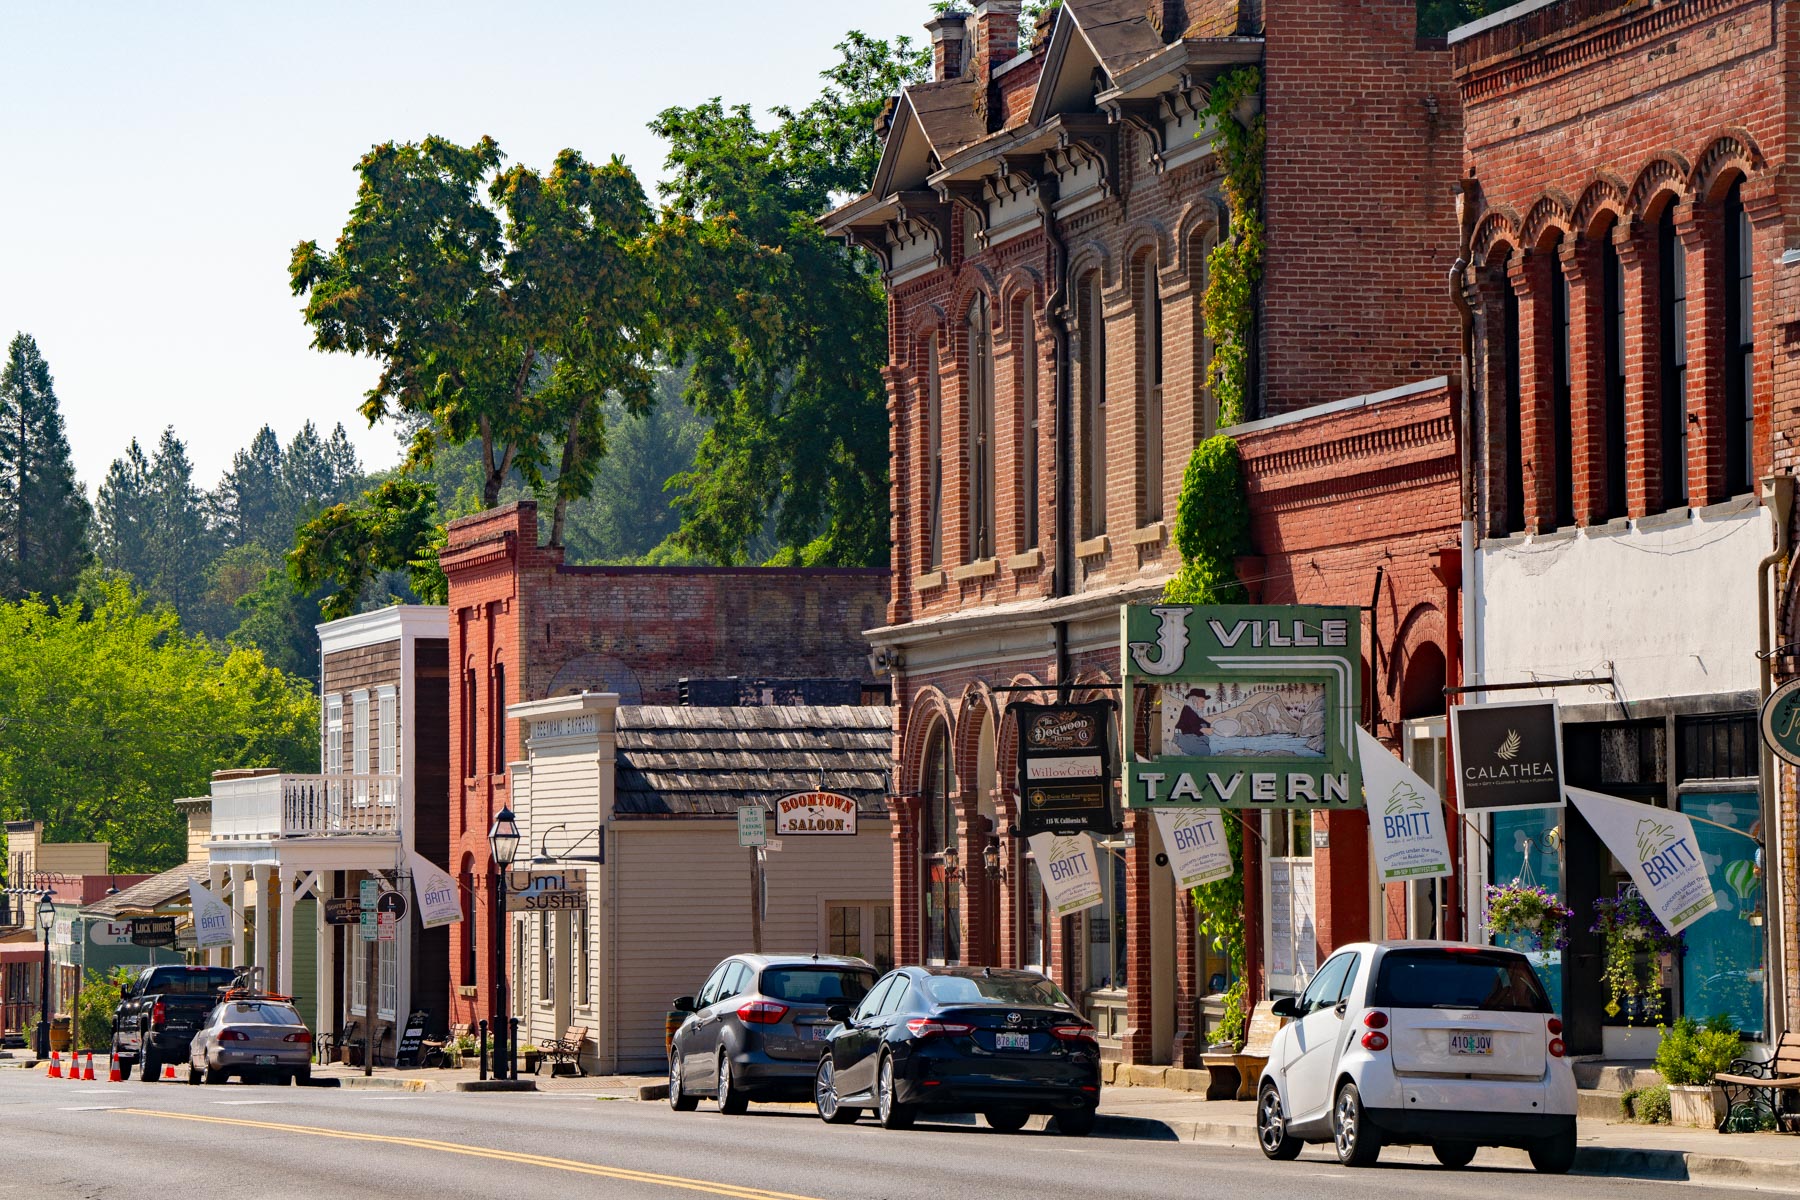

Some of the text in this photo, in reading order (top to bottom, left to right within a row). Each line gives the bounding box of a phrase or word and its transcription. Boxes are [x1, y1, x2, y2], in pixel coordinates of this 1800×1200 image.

[1128, 607, 1349, 676] J VILLE
[1030, 765, 1099, 777] WillowCreek
[1465, 762, 1554, 780] CALATHEA
[1138, 771, 1350, 801] TAVERN
[780, 793, 854, 814] BOOMTOWN
[788, 818, 845, 831] SALOON
[1384, 812, 1430, 839] BRITT
[1174, 821, 1216, 850] BRITT
[1049, 852, 1088, 881] BRITT
[1641, 837, 1697, 886] BRITT
[511, 870, 565, 891] Umi
[424, 888, 451, 905] BRITT
[525, 890, 580, 909] sushi
[1661, 891, 1681, 911] Concerts
[1680, 880, 1696, 894] under
[135, 921, 173, 933] LOCK HOUSE
[201, 915, 226, 929] BRITT
[996, 1036, 1029, 1047] 878 KGG
[1451, 1036, 1491, 1049] 410 JQV
